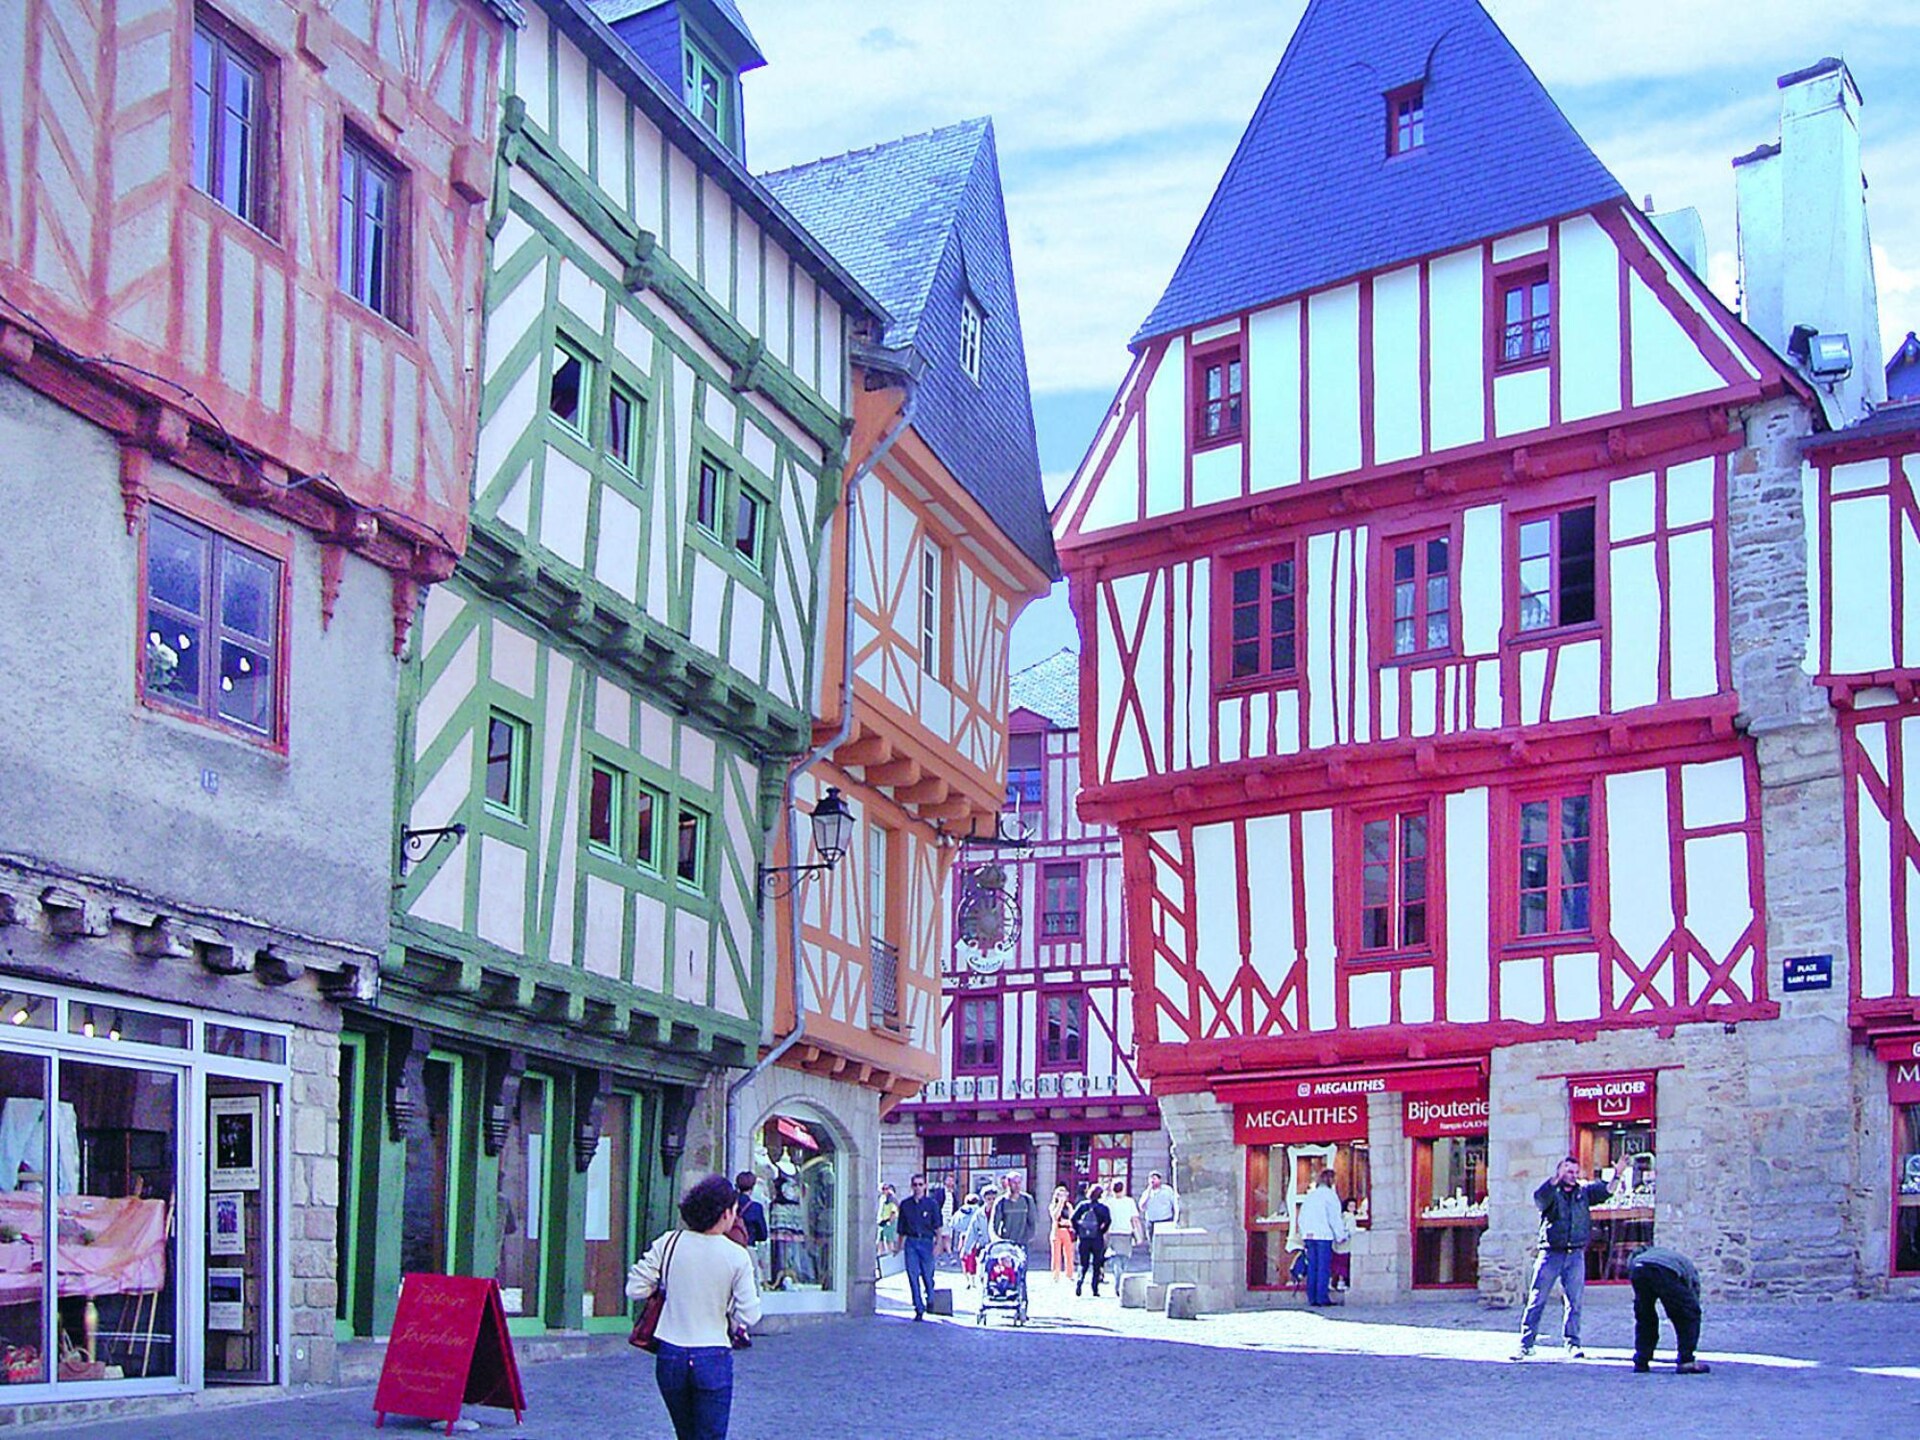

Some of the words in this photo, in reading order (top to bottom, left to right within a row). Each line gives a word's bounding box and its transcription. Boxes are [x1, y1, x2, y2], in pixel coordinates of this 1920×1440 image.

[1797, 963, 1817, 972] PLACE
[1806, 973, 1828, 982] PIERRE
[1006, 1076, 1117, 1095] AGRICOLE
[1314, 1079, 1385, 1095] MEGALITHES
[1573, 1084, 1603, 1099] François
[1605, 1081, 1646, 1096] GAUCHER
[1245, 1106, 1358, 1129] MEGALITHES
[1408, 1097, 1489, 1125] Bijouterie
